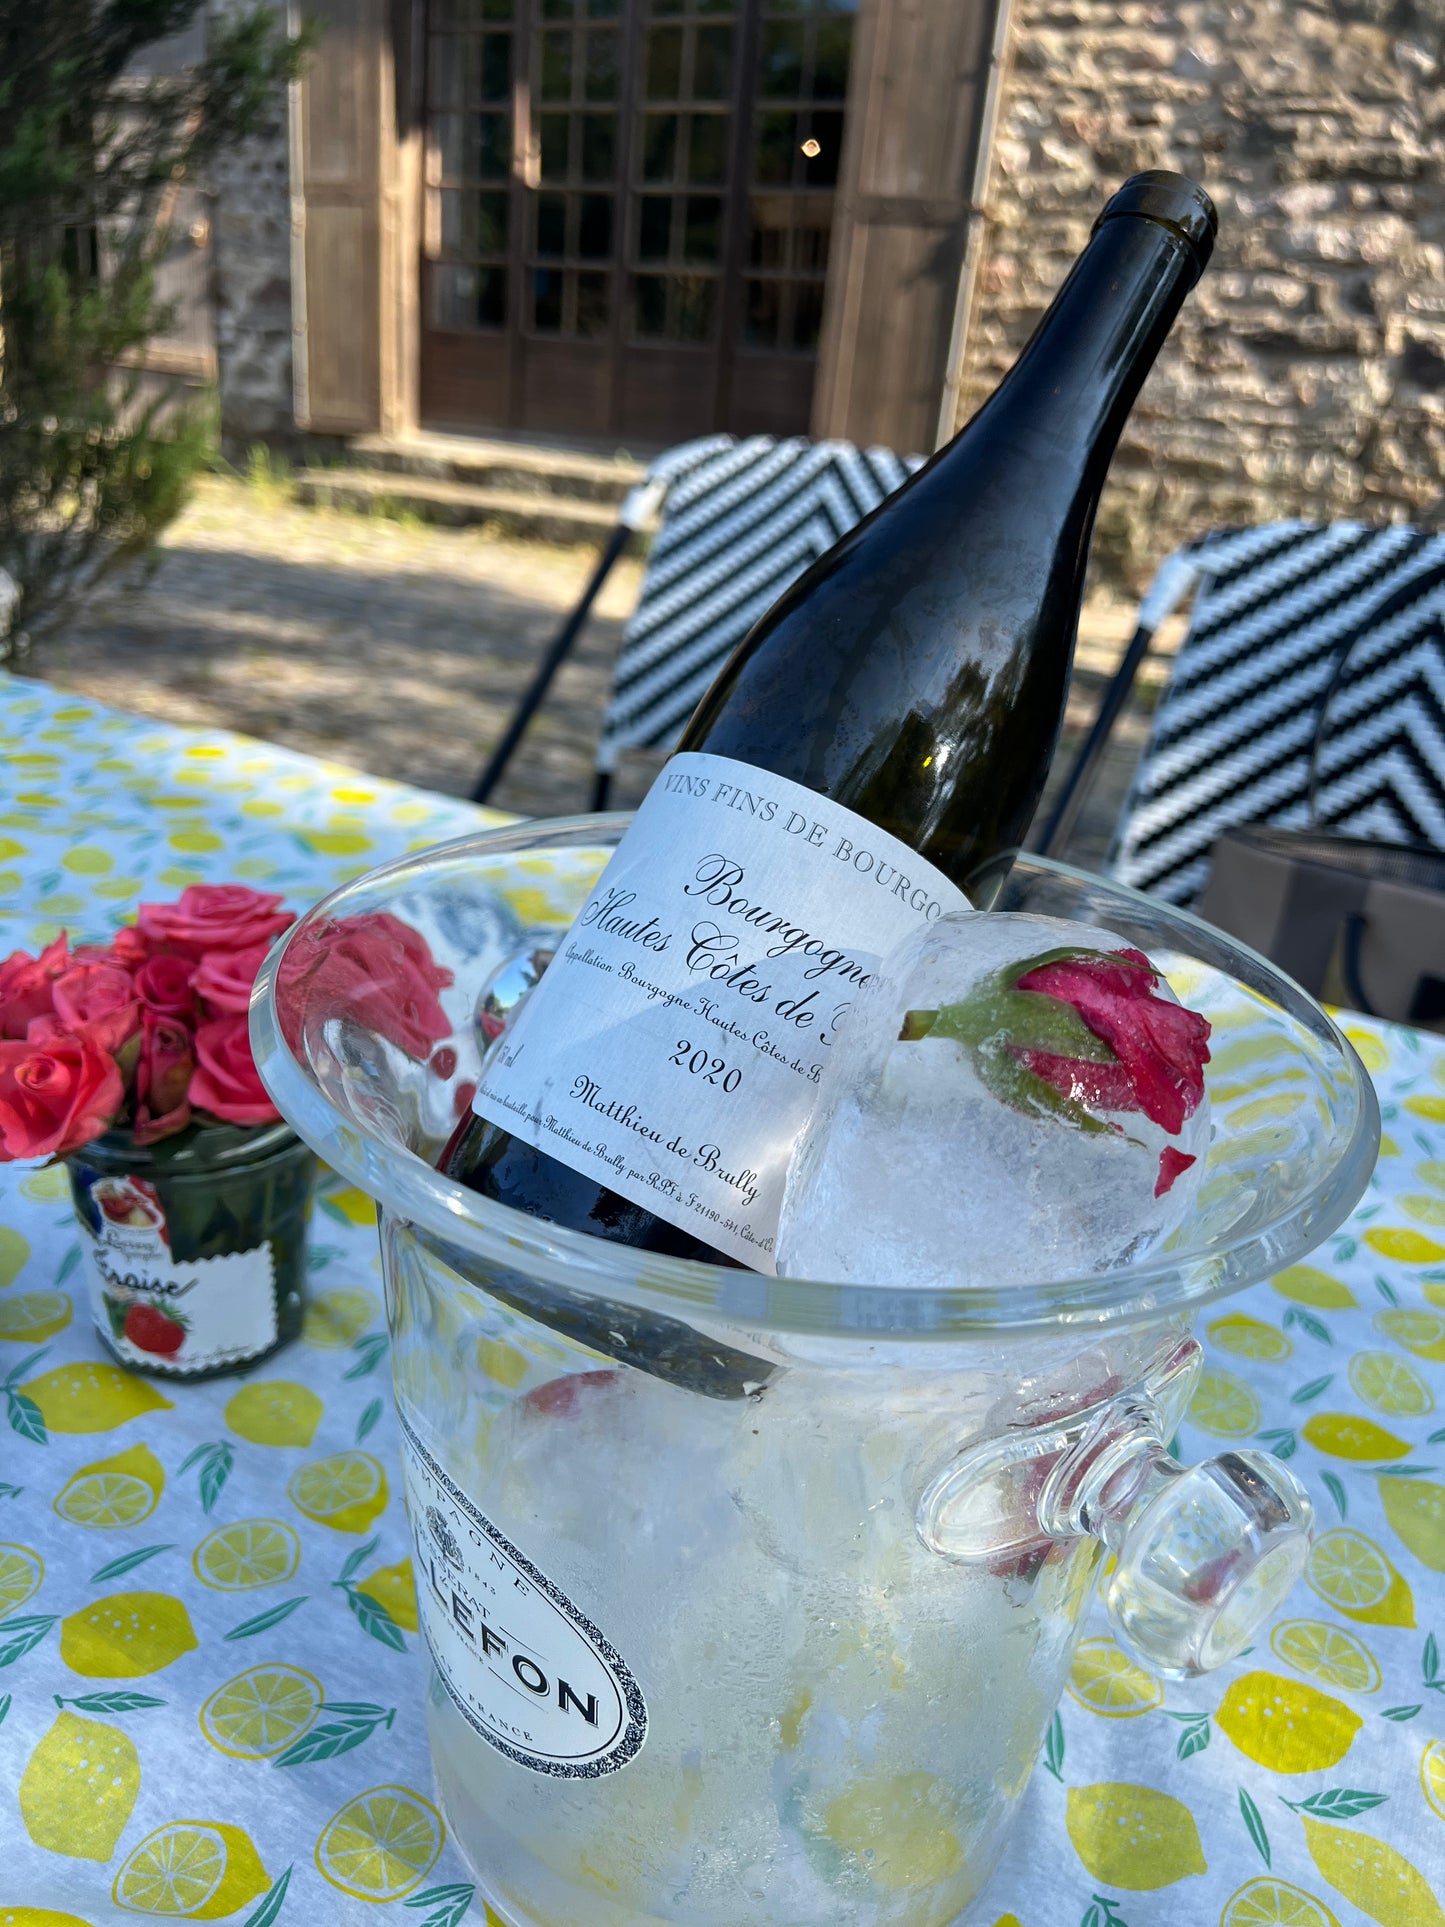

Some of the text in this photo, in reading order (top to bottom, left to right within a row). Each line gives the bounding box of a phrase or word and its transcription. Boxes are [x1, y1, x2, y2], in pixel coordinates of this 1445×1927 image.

[664, 773, 941, 922] VINS FINS DE BOURGO
[565, 941, 615, 966] Appellation
[617, 961, 693, 1008] Bourgogne
[693, 997, 751, 1041] Hautes
[752, 1030, 790, 1064] Côtes
[790, 1060, 806, 1075] de
[581, 888, 673, 952] Hautes
[685, 921, 772, 1003] Côtes
[775, 990, 820, 1028] de
[668, 1039, 742, 1094] 2020
[503, 1094, 528, 1117] bouteille
[524, 1113, 542, 1126] pour
[543, 1114, 583, 1146] Matthieu
[581, 1139, 593, 1152] de
[593, 1142, 627, 1176] Brully
[626, 1169, 647, 1183] par
[569, 1074, 762, 1206] Matthieu de Brully
[409, 1452, 531, 1597] AMPAGNE
[468, 1692, 533, 1742] FRANCE
